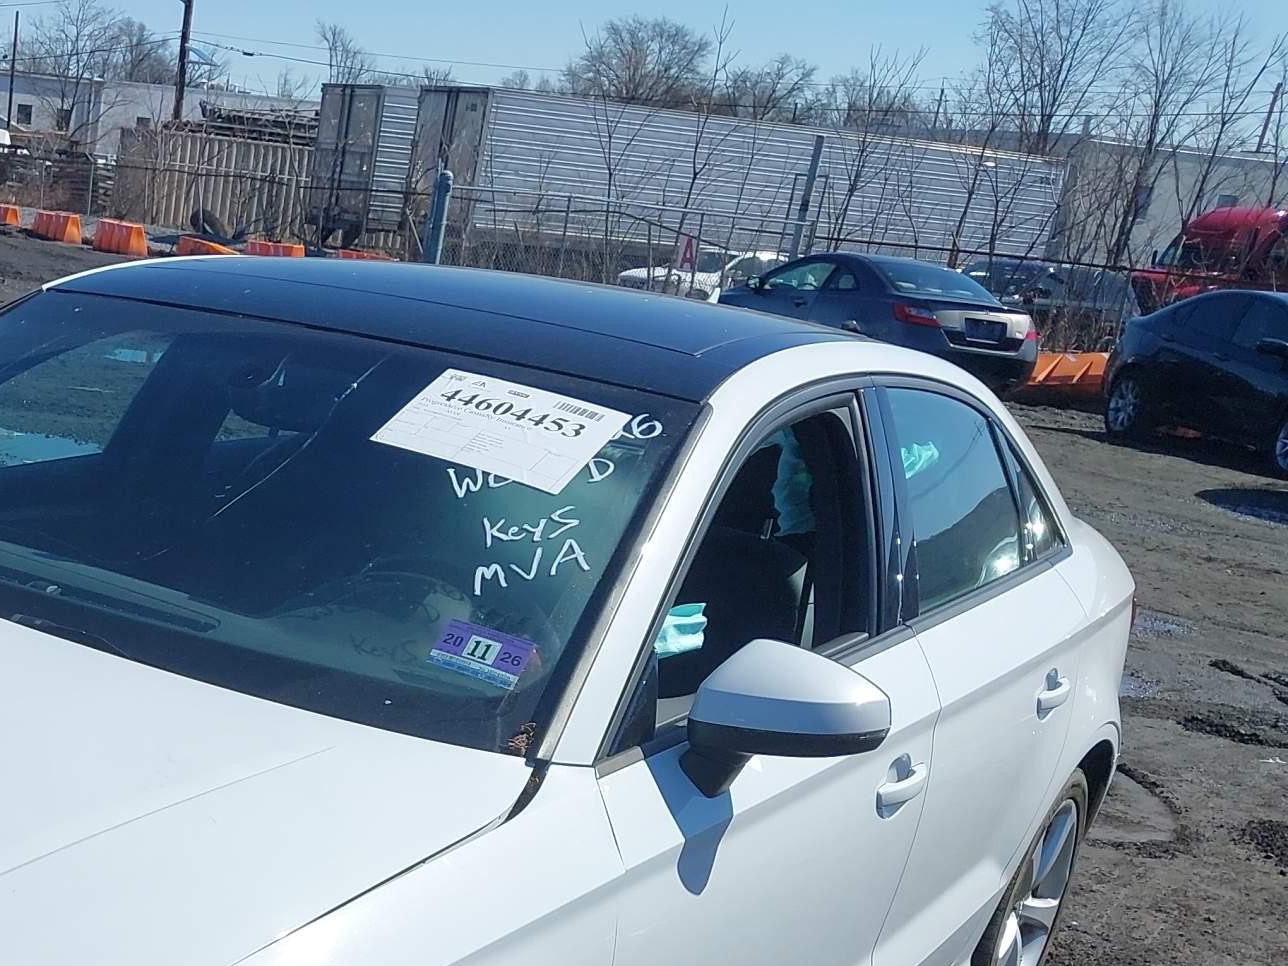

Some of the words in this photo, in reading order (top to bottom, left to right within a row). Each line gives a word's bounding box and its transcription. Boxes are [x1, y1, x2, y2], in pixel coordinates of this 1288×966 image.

[440, 389, 586, 438] 44604453
[473, 538, 591, 596] MVA
[443, 633, 464, 648] 20
[467, 640, 493, 661] 11
[499, 651, 523, 667] 26
